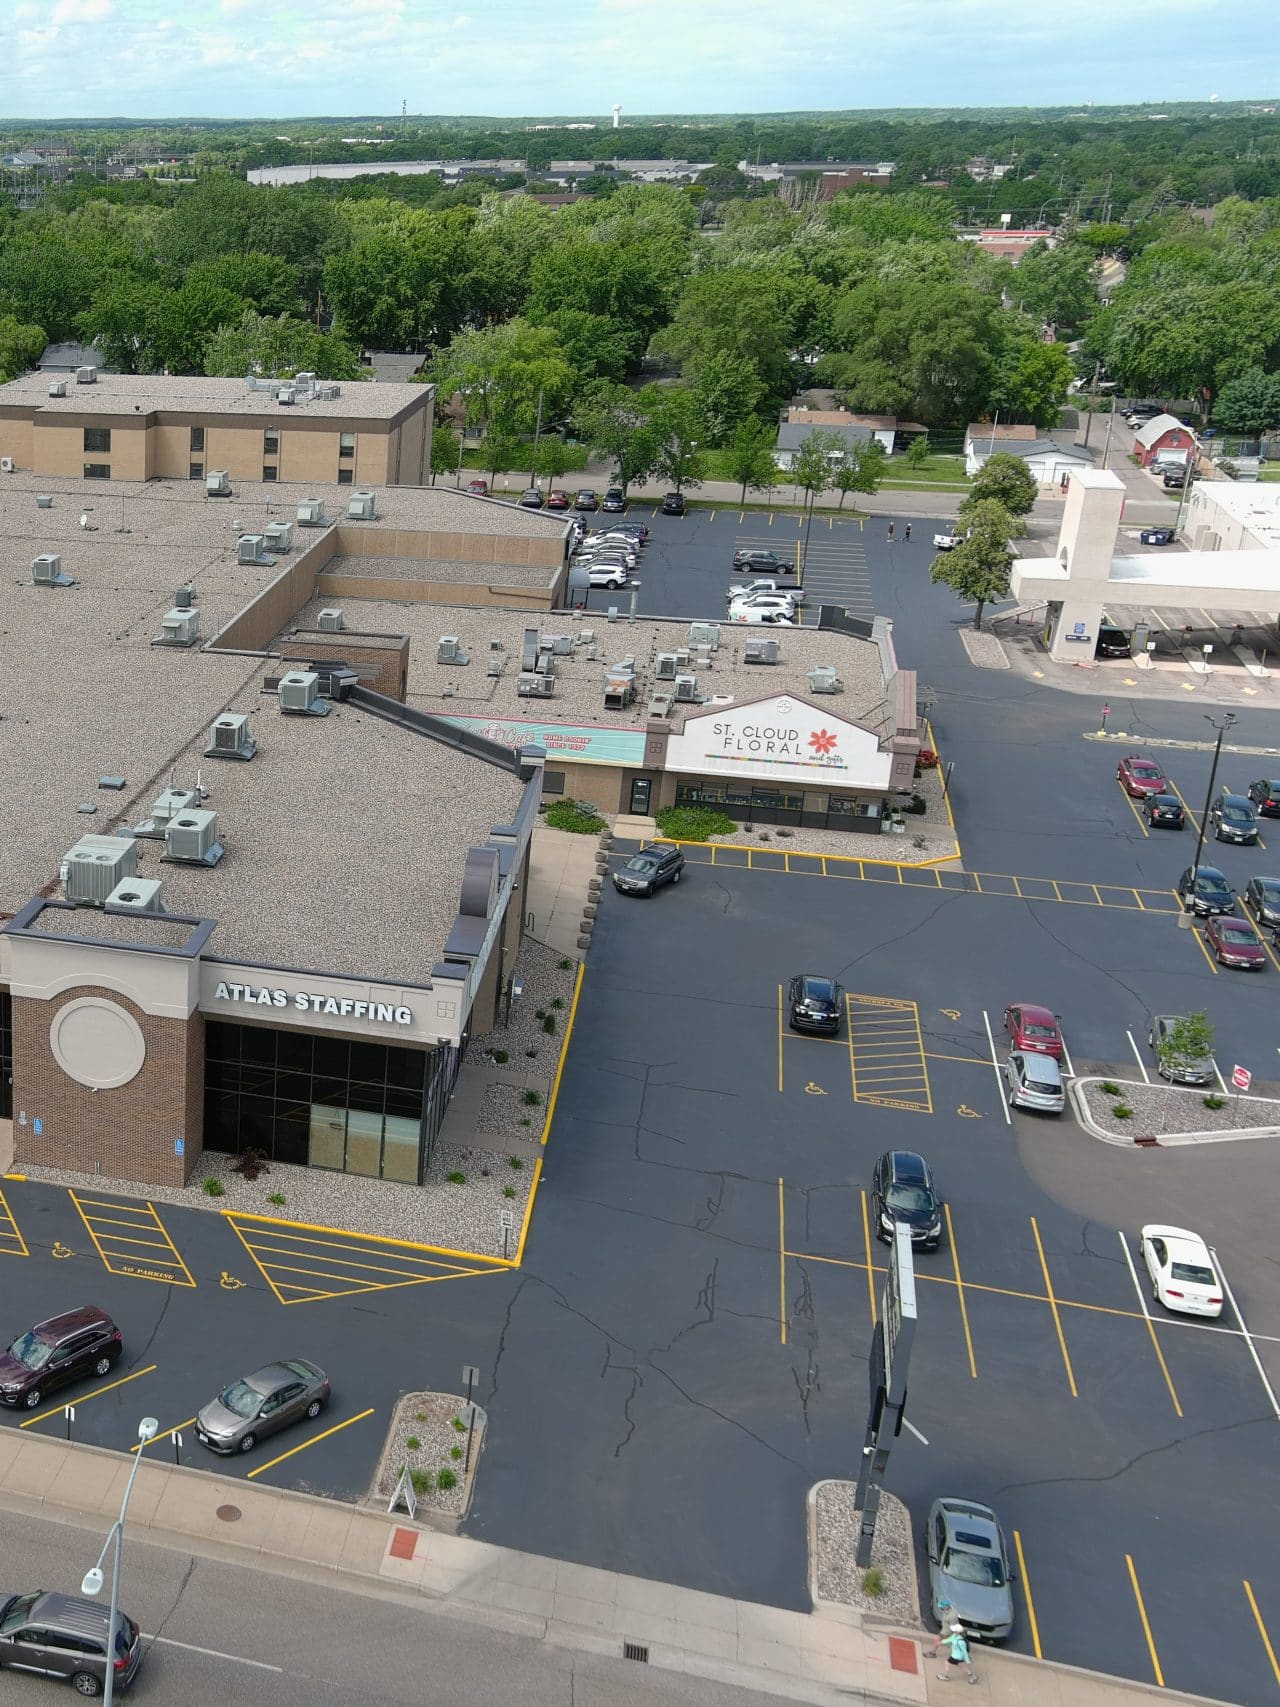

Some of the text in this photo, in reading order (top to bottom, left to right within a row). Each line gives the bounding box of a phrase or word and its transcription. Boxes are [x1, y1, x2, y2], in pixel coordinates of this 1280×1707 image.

[713, 723, 799, 741] ST. CLOUD
[723, 737, 802, 755] FLORAL
[808, 753, 844, 765] and gifts
[214, 982, 412, 1026] ATLAS STAFFING
[136, 1269, 175, 1280] PARKING
